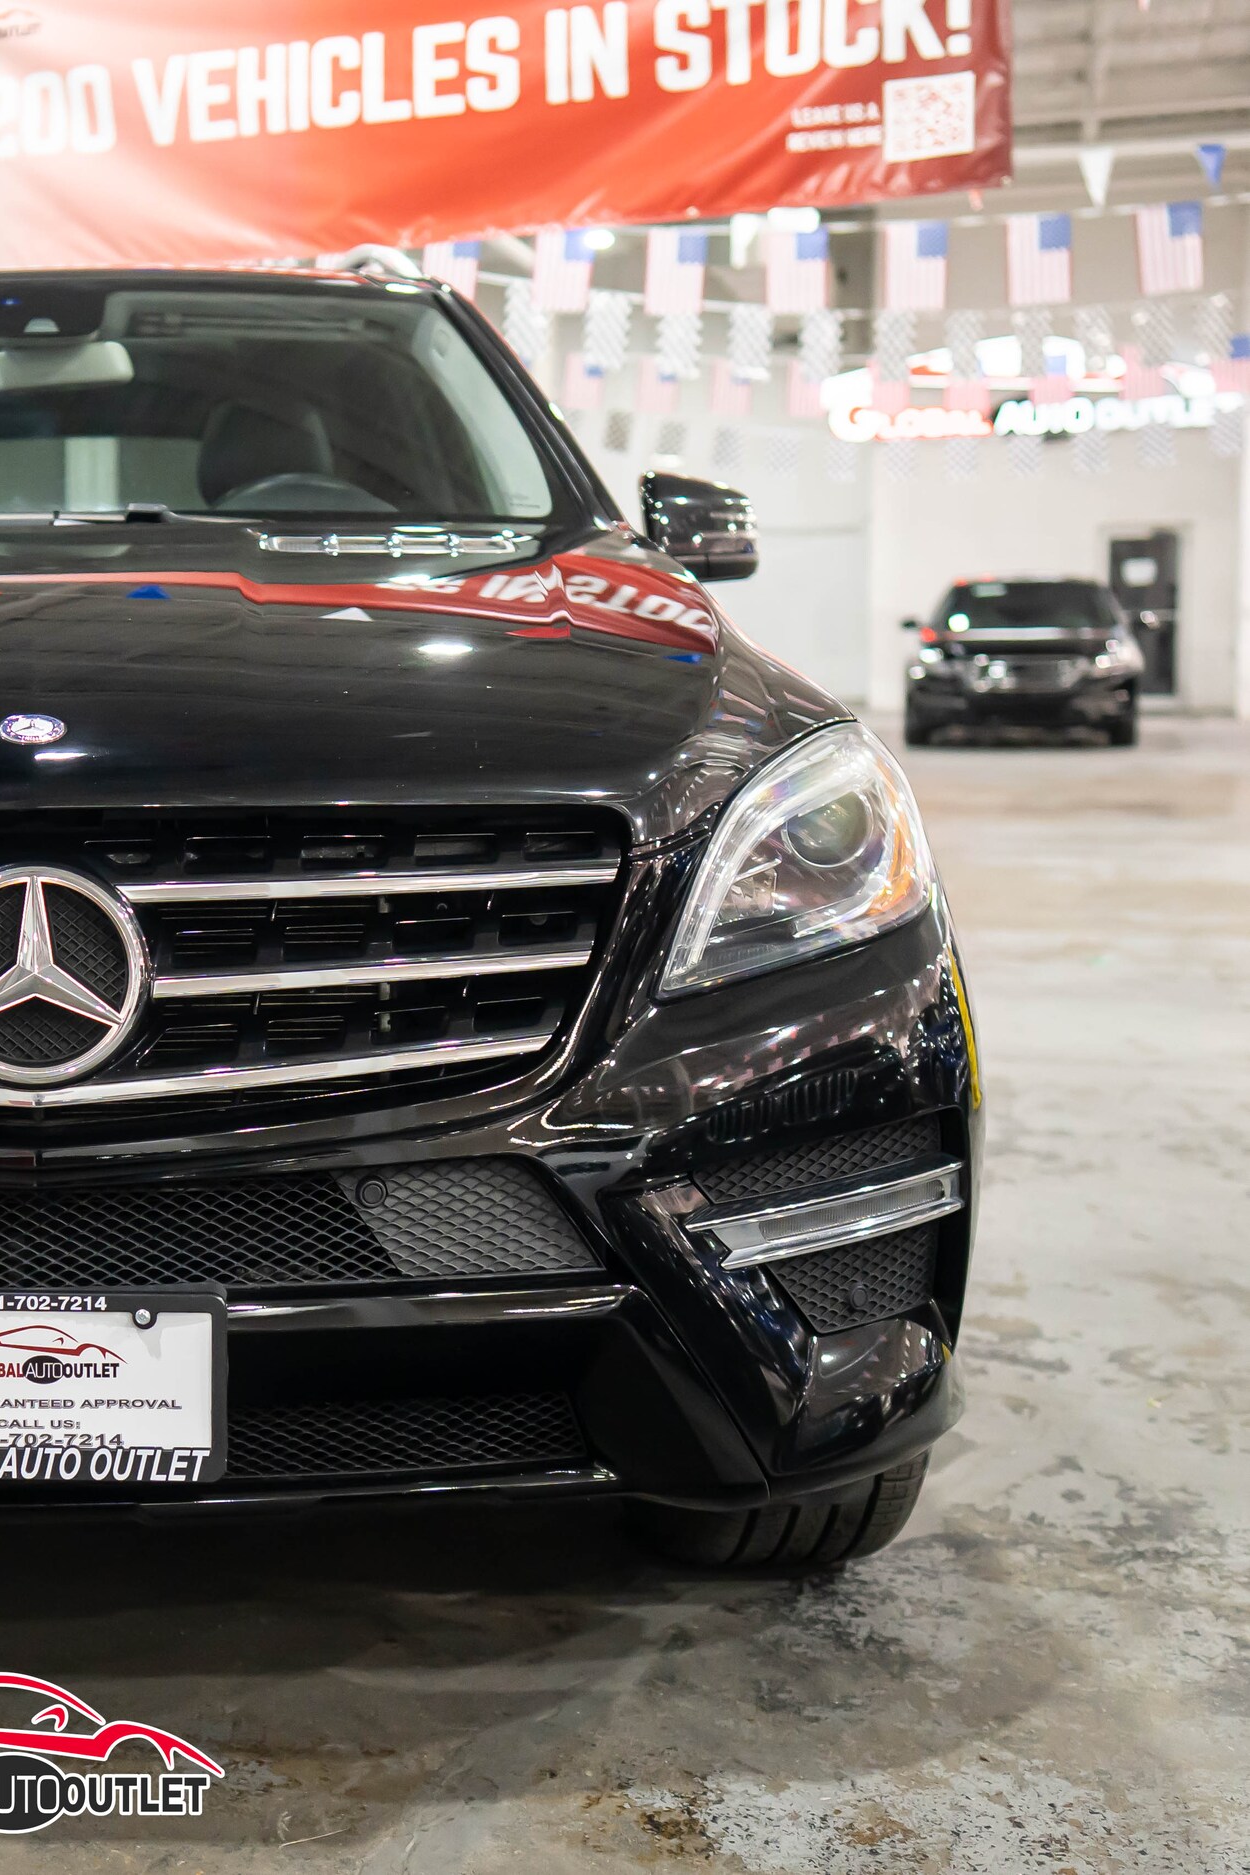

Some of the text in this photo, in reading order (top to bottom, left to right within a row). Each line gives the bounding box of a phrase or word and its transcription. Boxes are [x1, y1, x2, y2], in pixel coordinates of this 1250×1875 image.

[131, 16, 520, 147] VEHICLES
[545, 1, 629, 106] IN
[654, 0, 972, 92] STOCK!
[81, 1398, 182, 1410] APPROVAL
[50, 1419, 81, 1430] US:
[90, 1449, 209, 1482] OUTLET
